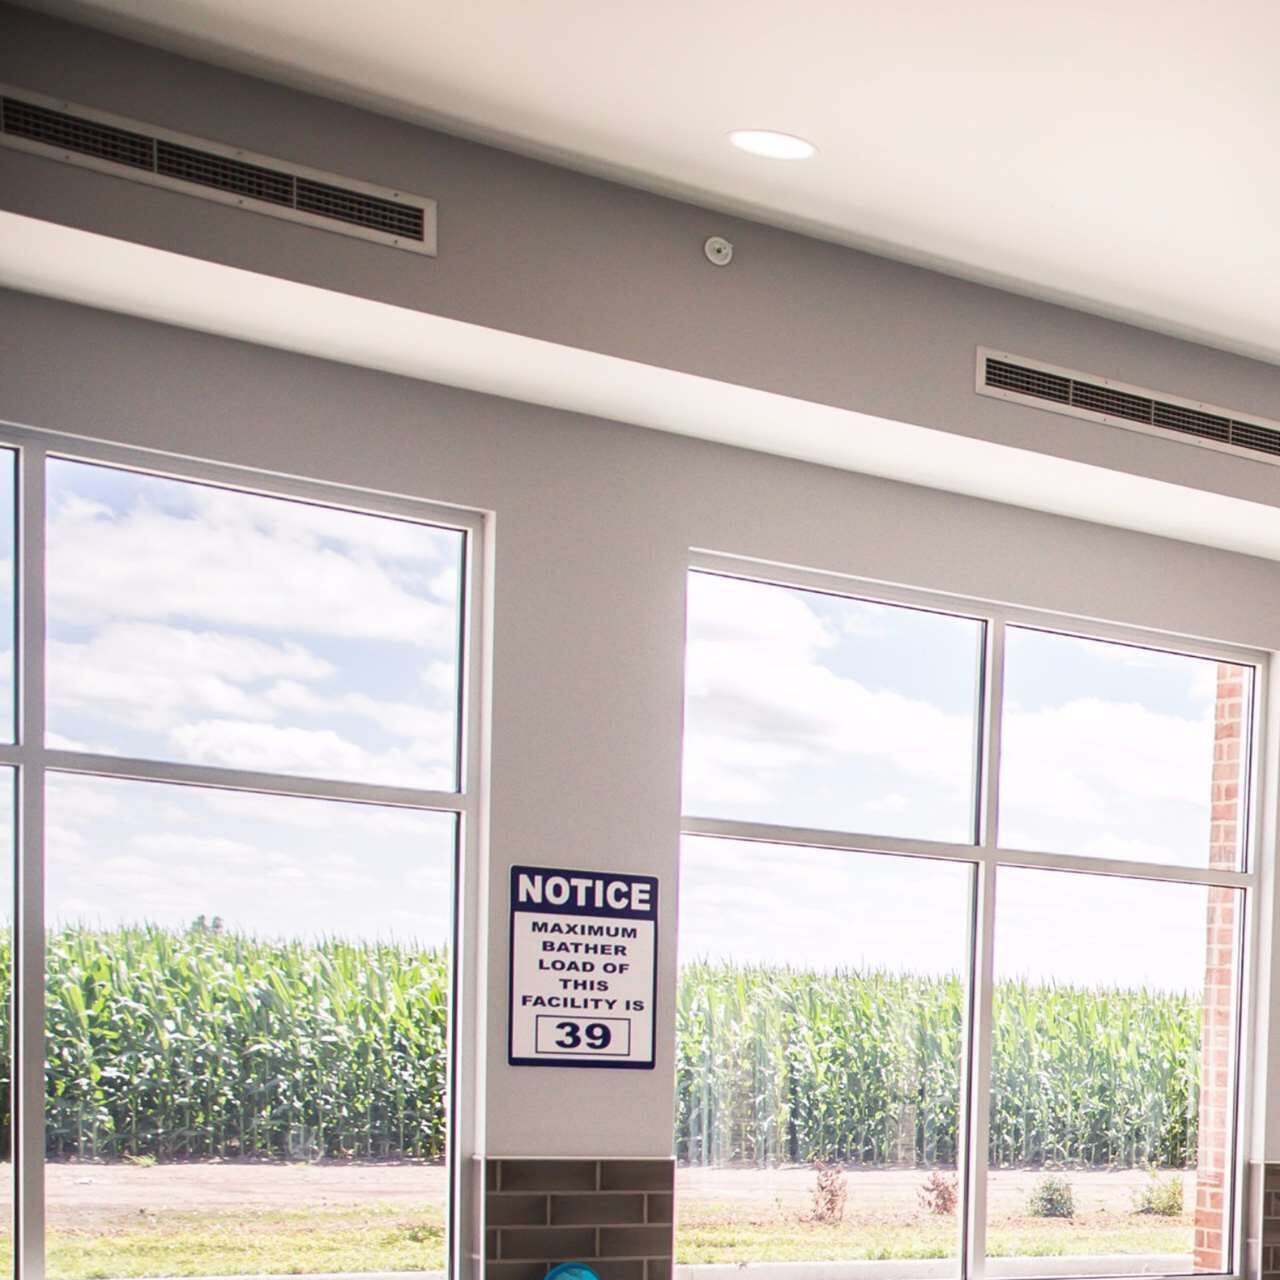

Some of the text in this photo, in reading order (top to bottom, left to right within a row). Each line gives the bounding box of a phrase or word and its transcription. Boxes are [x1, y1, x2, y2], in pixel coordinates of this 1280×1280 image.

[518, 874, 650, 911] NOTICE
[531, 921, 637, 938] MAXIMUM
[542, 941, 627, 956] BATHER
[538, 959, 630, 974] LOAD OF
[559, 978, 609, 991] THIS
[521, 995, 645, 1011] FACILITY IS
[555, 1021, 611, 1050] 39
